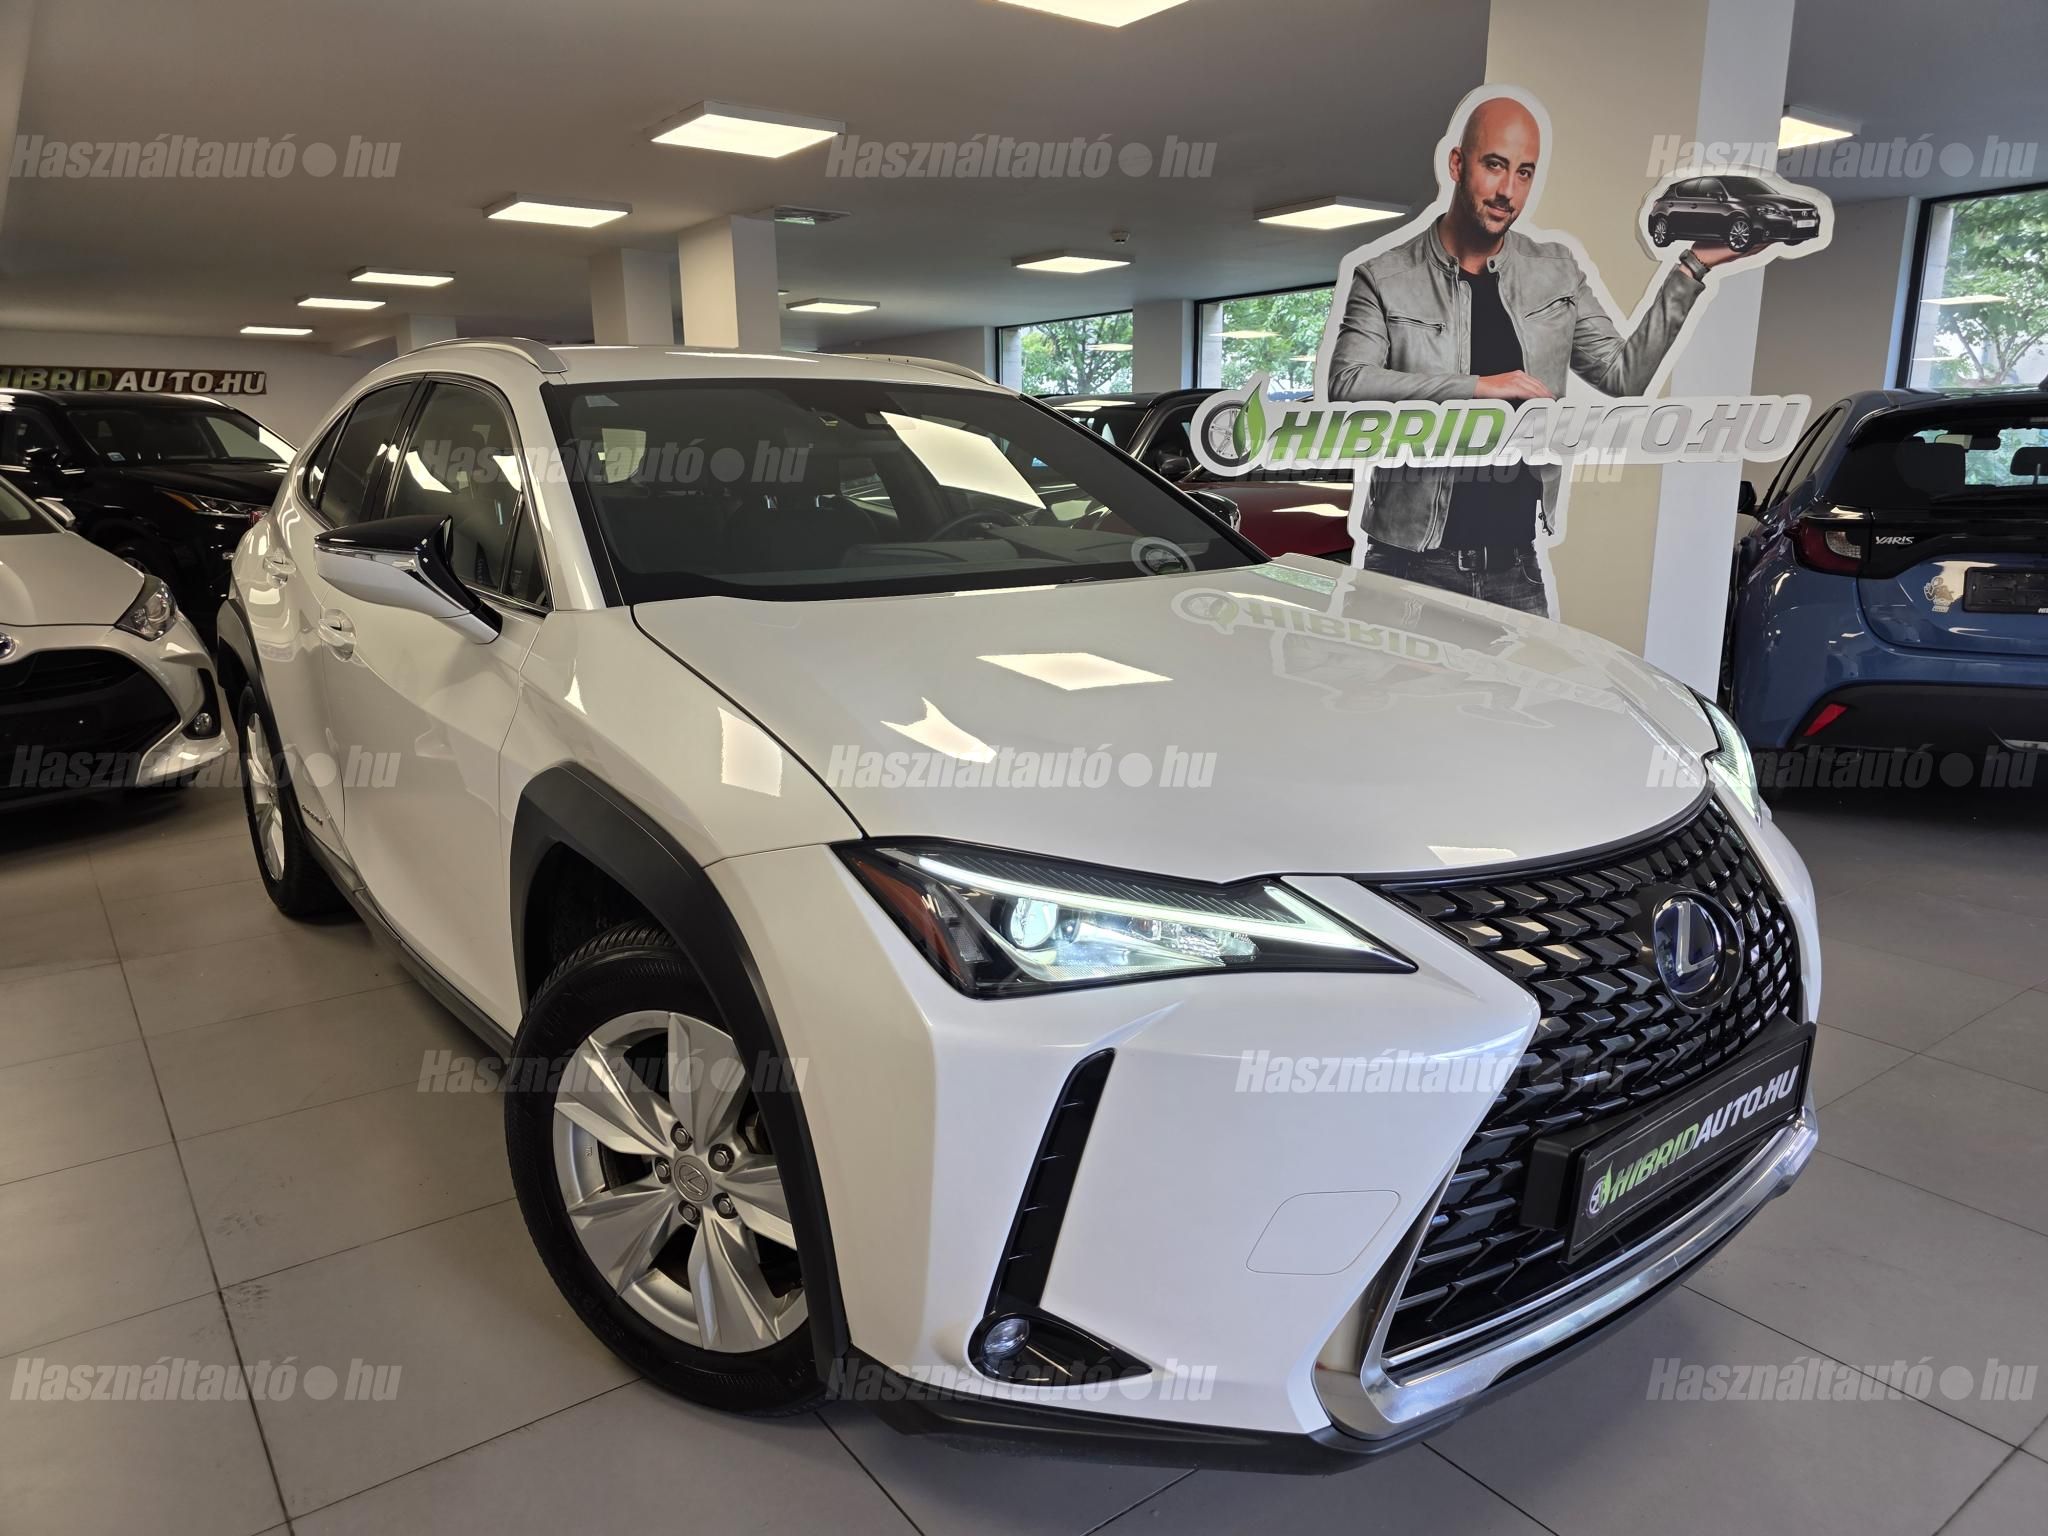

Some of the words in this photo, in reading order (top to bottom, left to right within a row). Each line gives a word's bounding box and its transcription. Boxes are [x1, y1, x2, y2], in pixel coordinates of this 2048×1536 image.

[1268, 401, 1799, 461] HIBRIDAUTO.HU
[1875, 536, 1914, 545] YARIS
[1608, 1064, 1800, 1205] HIBRIDAUTO.HU
